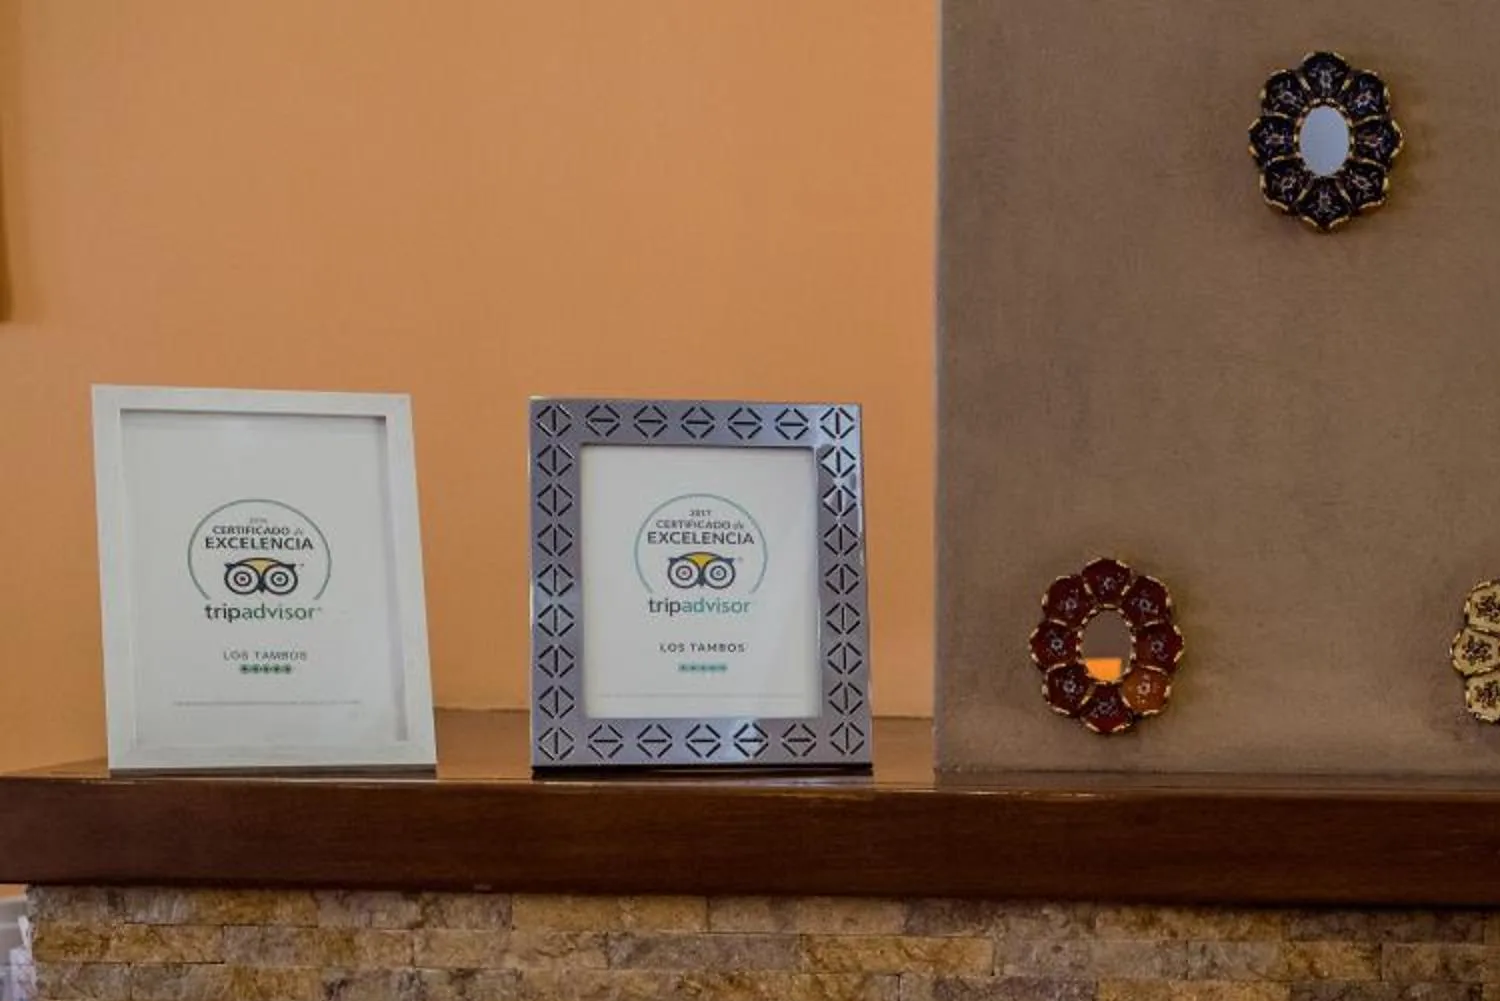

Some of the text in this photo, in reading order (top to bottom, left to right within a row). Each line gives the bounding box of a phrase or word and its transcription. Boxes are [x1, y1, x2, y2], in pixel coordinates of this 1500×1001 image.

[212, 525, 291, 536] CERTIFICADO
[656, 519, 731, 530] CERTIFICADO
[205, 536, 313, 550] EXCELENCIA
[647, 531, 755, 545] EXCELENCIA
[204, 602, 315, 623] tripadvisor
[649, 597, 751, 617] tripadvisor
[659, 643, 745, 653] LOS TAMBOS
[254, 650, 307, 661] TAMBOS
